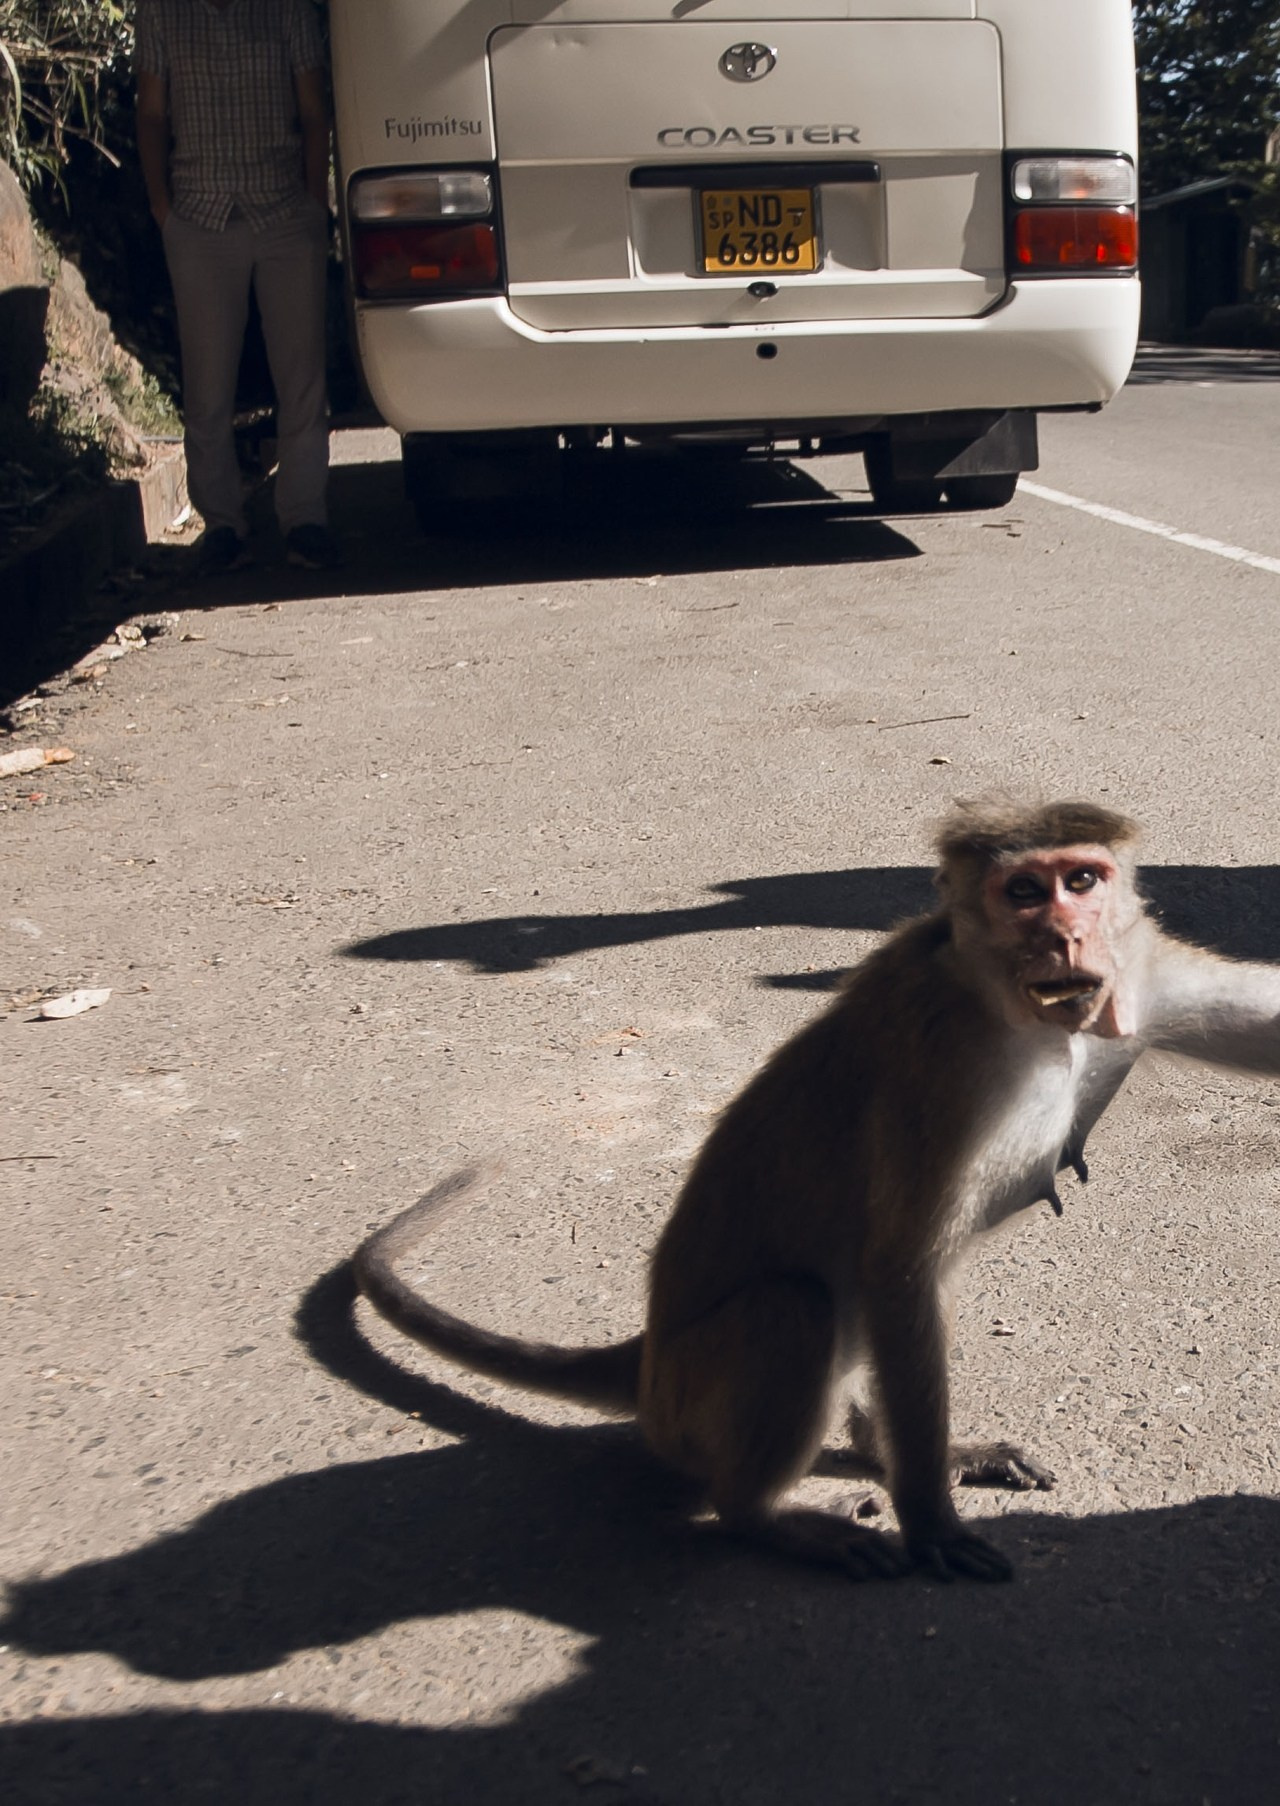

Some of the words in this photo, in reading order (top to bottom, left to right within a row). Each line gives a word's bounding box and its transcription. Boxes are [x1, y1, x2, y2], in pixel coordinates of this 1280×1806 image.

[384, 115, 482, 143] Fujimitsu
[656, 124, 861, 148] COASTER
[709, 211, 733, 229] SP
[717, 231, 800, 265] 6386
